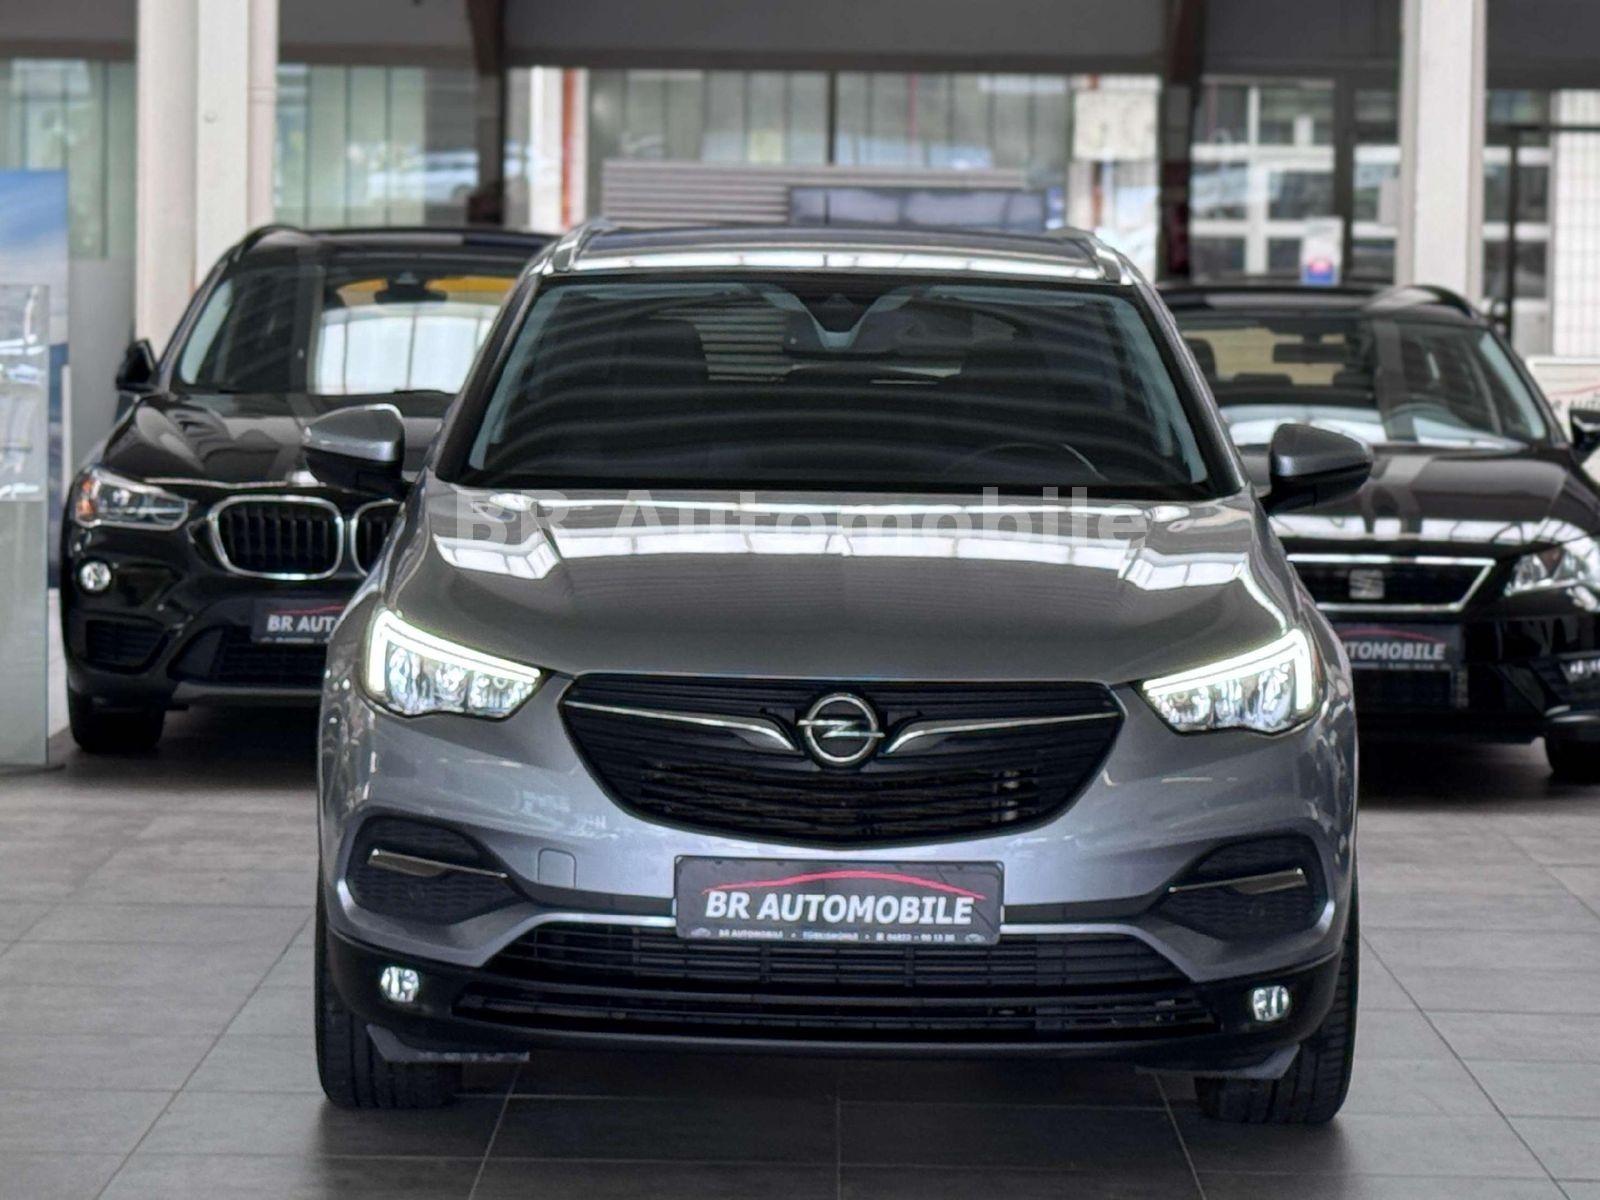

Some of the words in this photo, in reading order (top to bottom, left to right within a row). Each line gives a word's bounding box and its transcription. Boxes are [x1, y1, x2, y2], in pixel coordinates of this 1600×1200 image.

[267, 614, 294, 632] BR
[296, 615, 337, 632] AUT
[1342, 642, 1446, 660] TOMOBILE
[705, 891, 751, 919] BR
[756, 892, 974, 925] AUTOMOBILE
